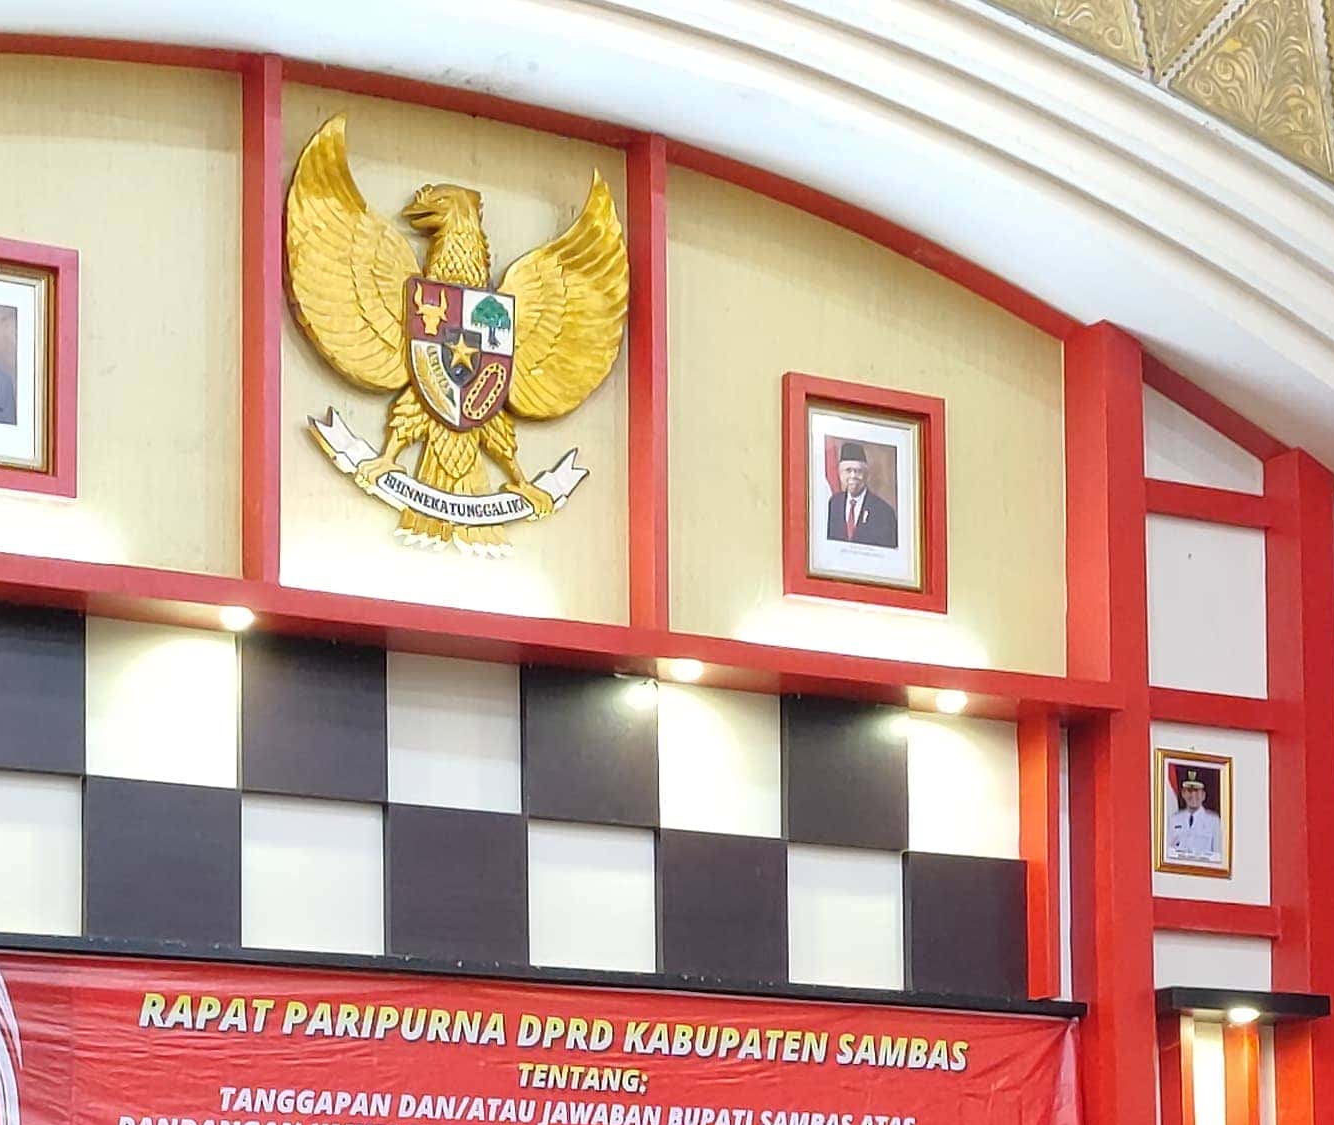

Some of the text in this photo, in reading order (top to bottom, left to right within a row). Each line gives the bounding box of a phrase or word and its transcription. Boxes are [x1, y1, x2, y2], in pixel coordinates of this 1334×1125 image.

[139, 993, 968, 1071] RAPAT PARIPURNA DPRD KABUPATEN SAMBAS
[518, 1063, 648, 1095] TENTANG:
[220, 1087, 391, 1117] TANGGAPAN
[398, 1094, 536, 1123] DAN/ATAU
